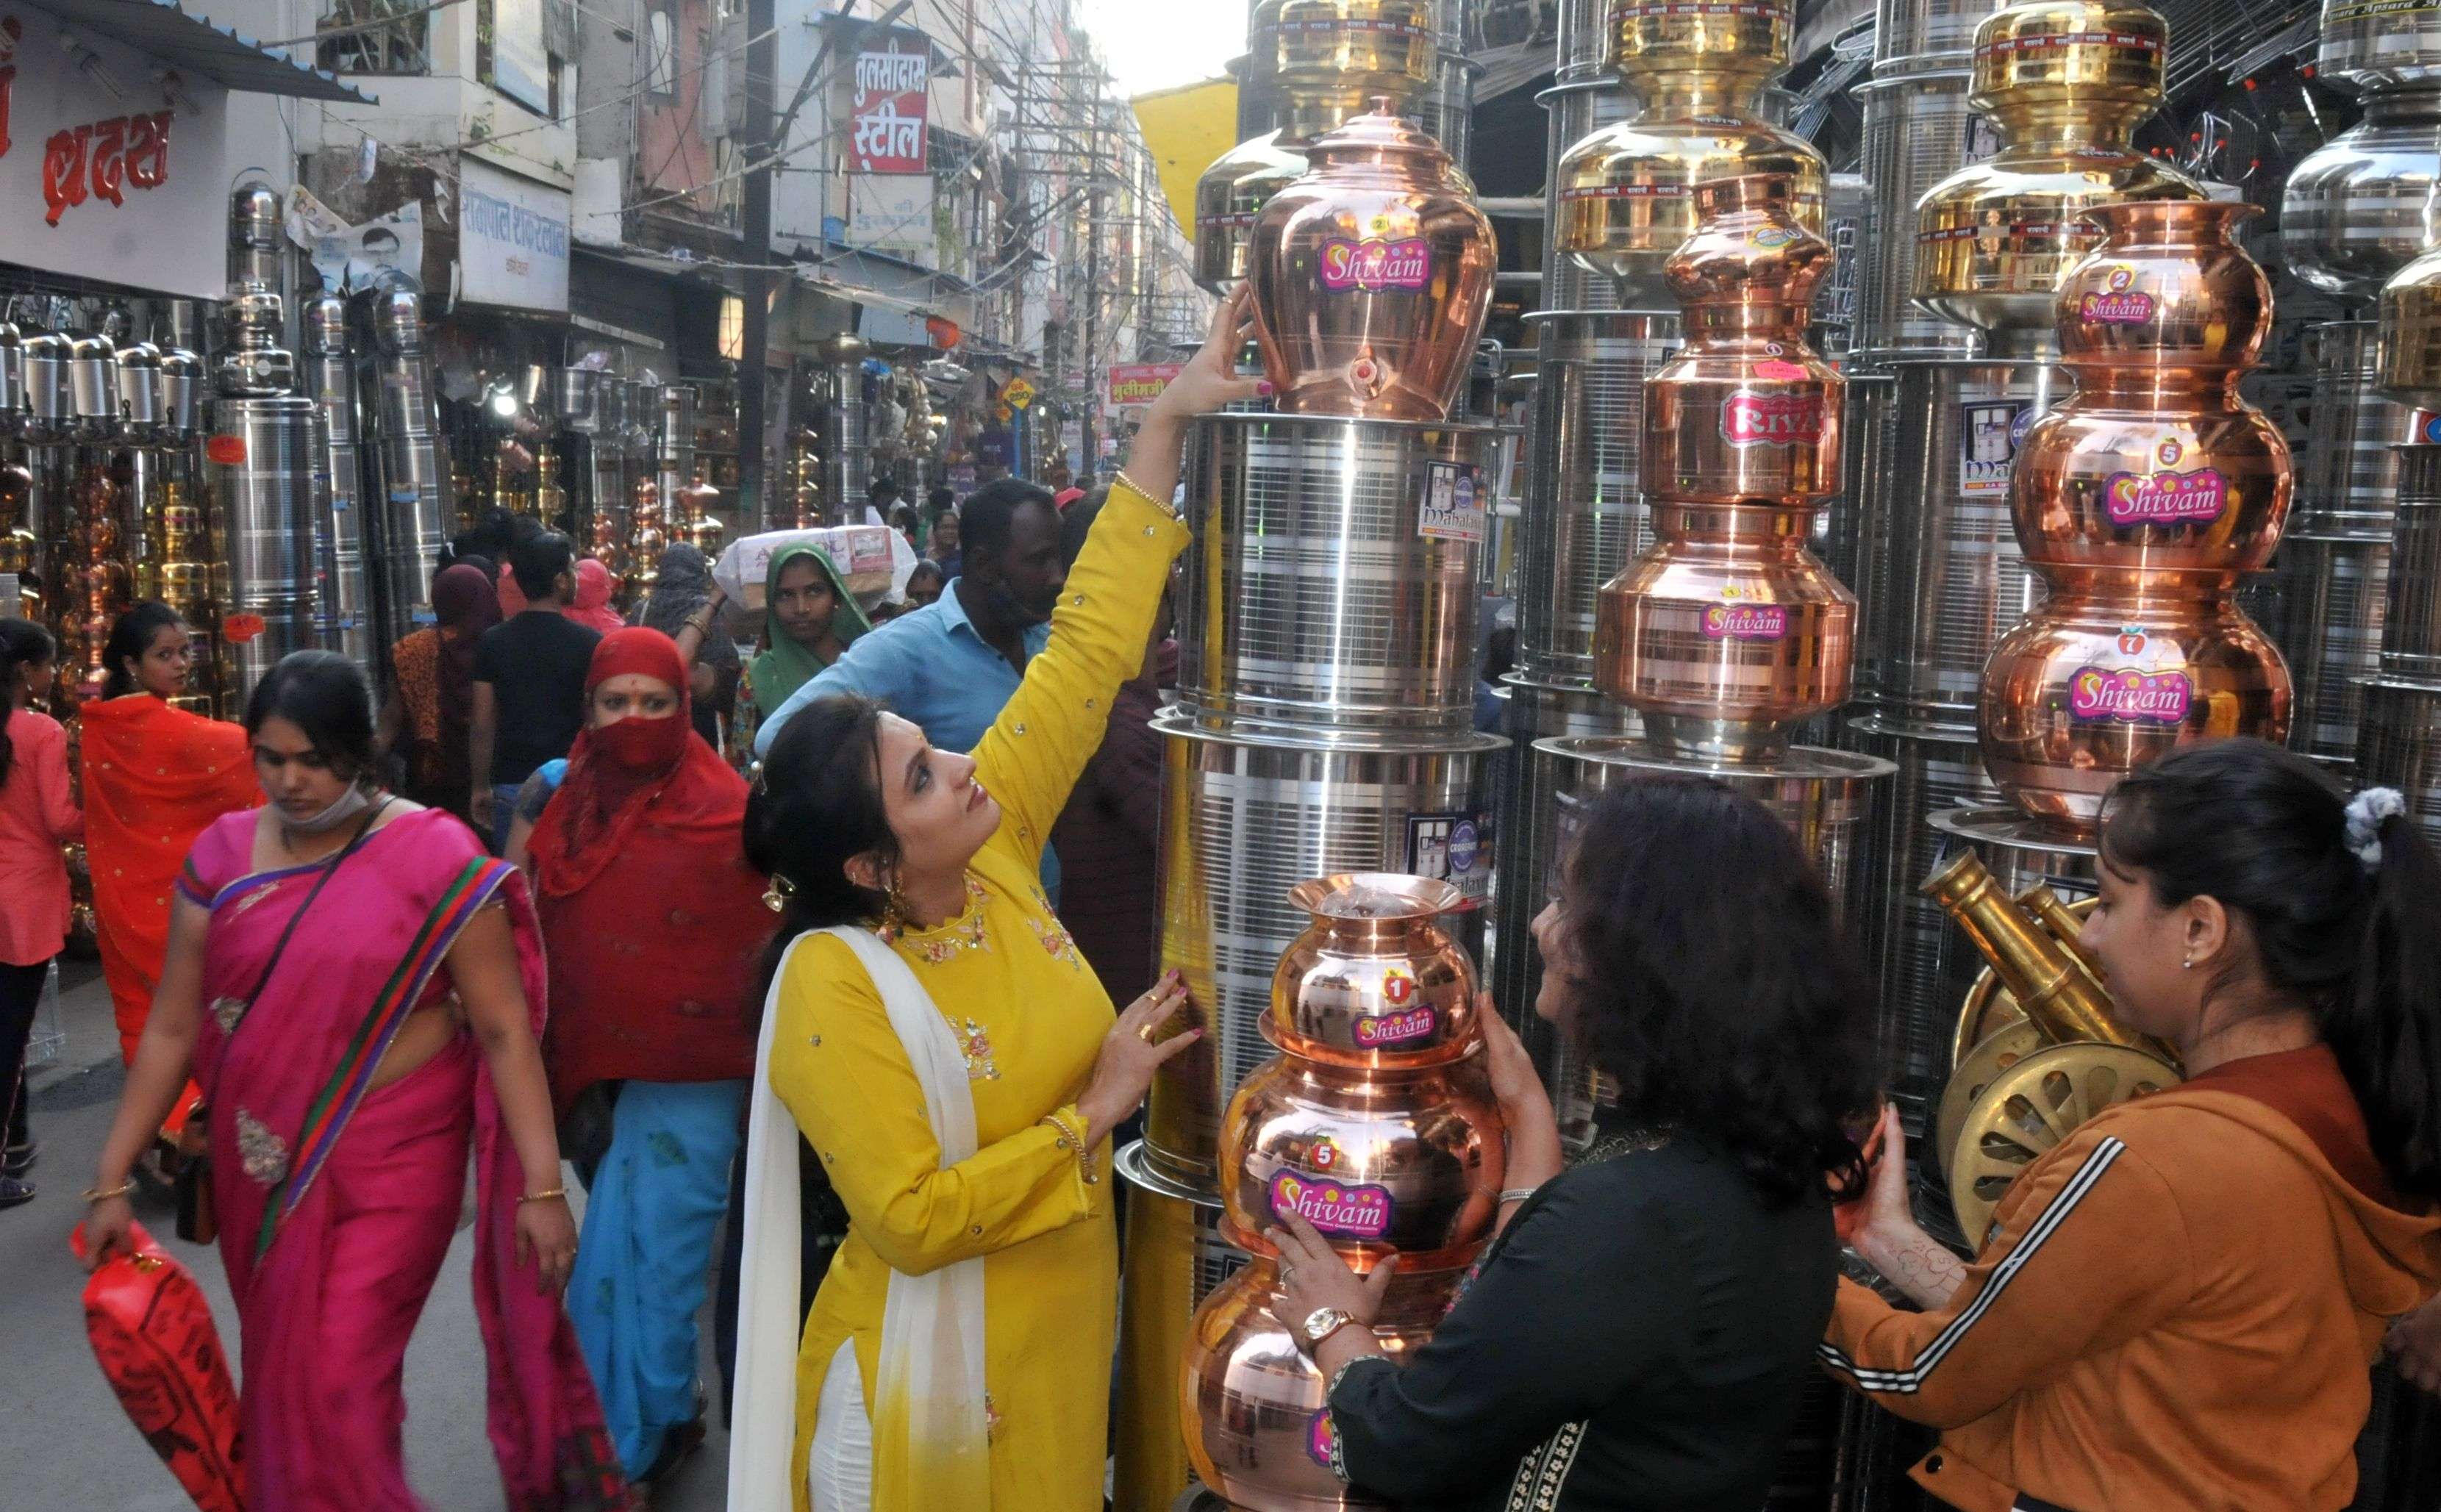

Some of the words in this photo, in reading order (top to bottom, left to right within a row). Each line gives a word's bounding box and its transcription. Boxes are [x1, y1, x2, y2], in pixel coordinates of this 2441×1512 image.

[2361, 1, 2413, 14] Apsara
[854, 37, 926, 108] तुलसीदास
[854, 101, 921, 159] स्टील
[1326, 246, 1424, 281] Shivam
[2112, 271, 2129, 288] 2
[2084, 298, 2145, 316] Shivam
[1734, 405, 1821, 434] RIYA
[2162, 446, 2177, 462] 5
[2113, 483, 2217, 515] Shivam
[1708, 611, 1781, 631] Shivam
[2125, 636, 2138, 653] 7
[2076, 676, 2181, 709] Shivam
[1390, 980, 1401, 998] 1
[1361, 1017, 1431, 1041] Shivam
[1317, 1146, 1332, 1165] 5
[1276, 1183, 1382, 1226] Shivam
